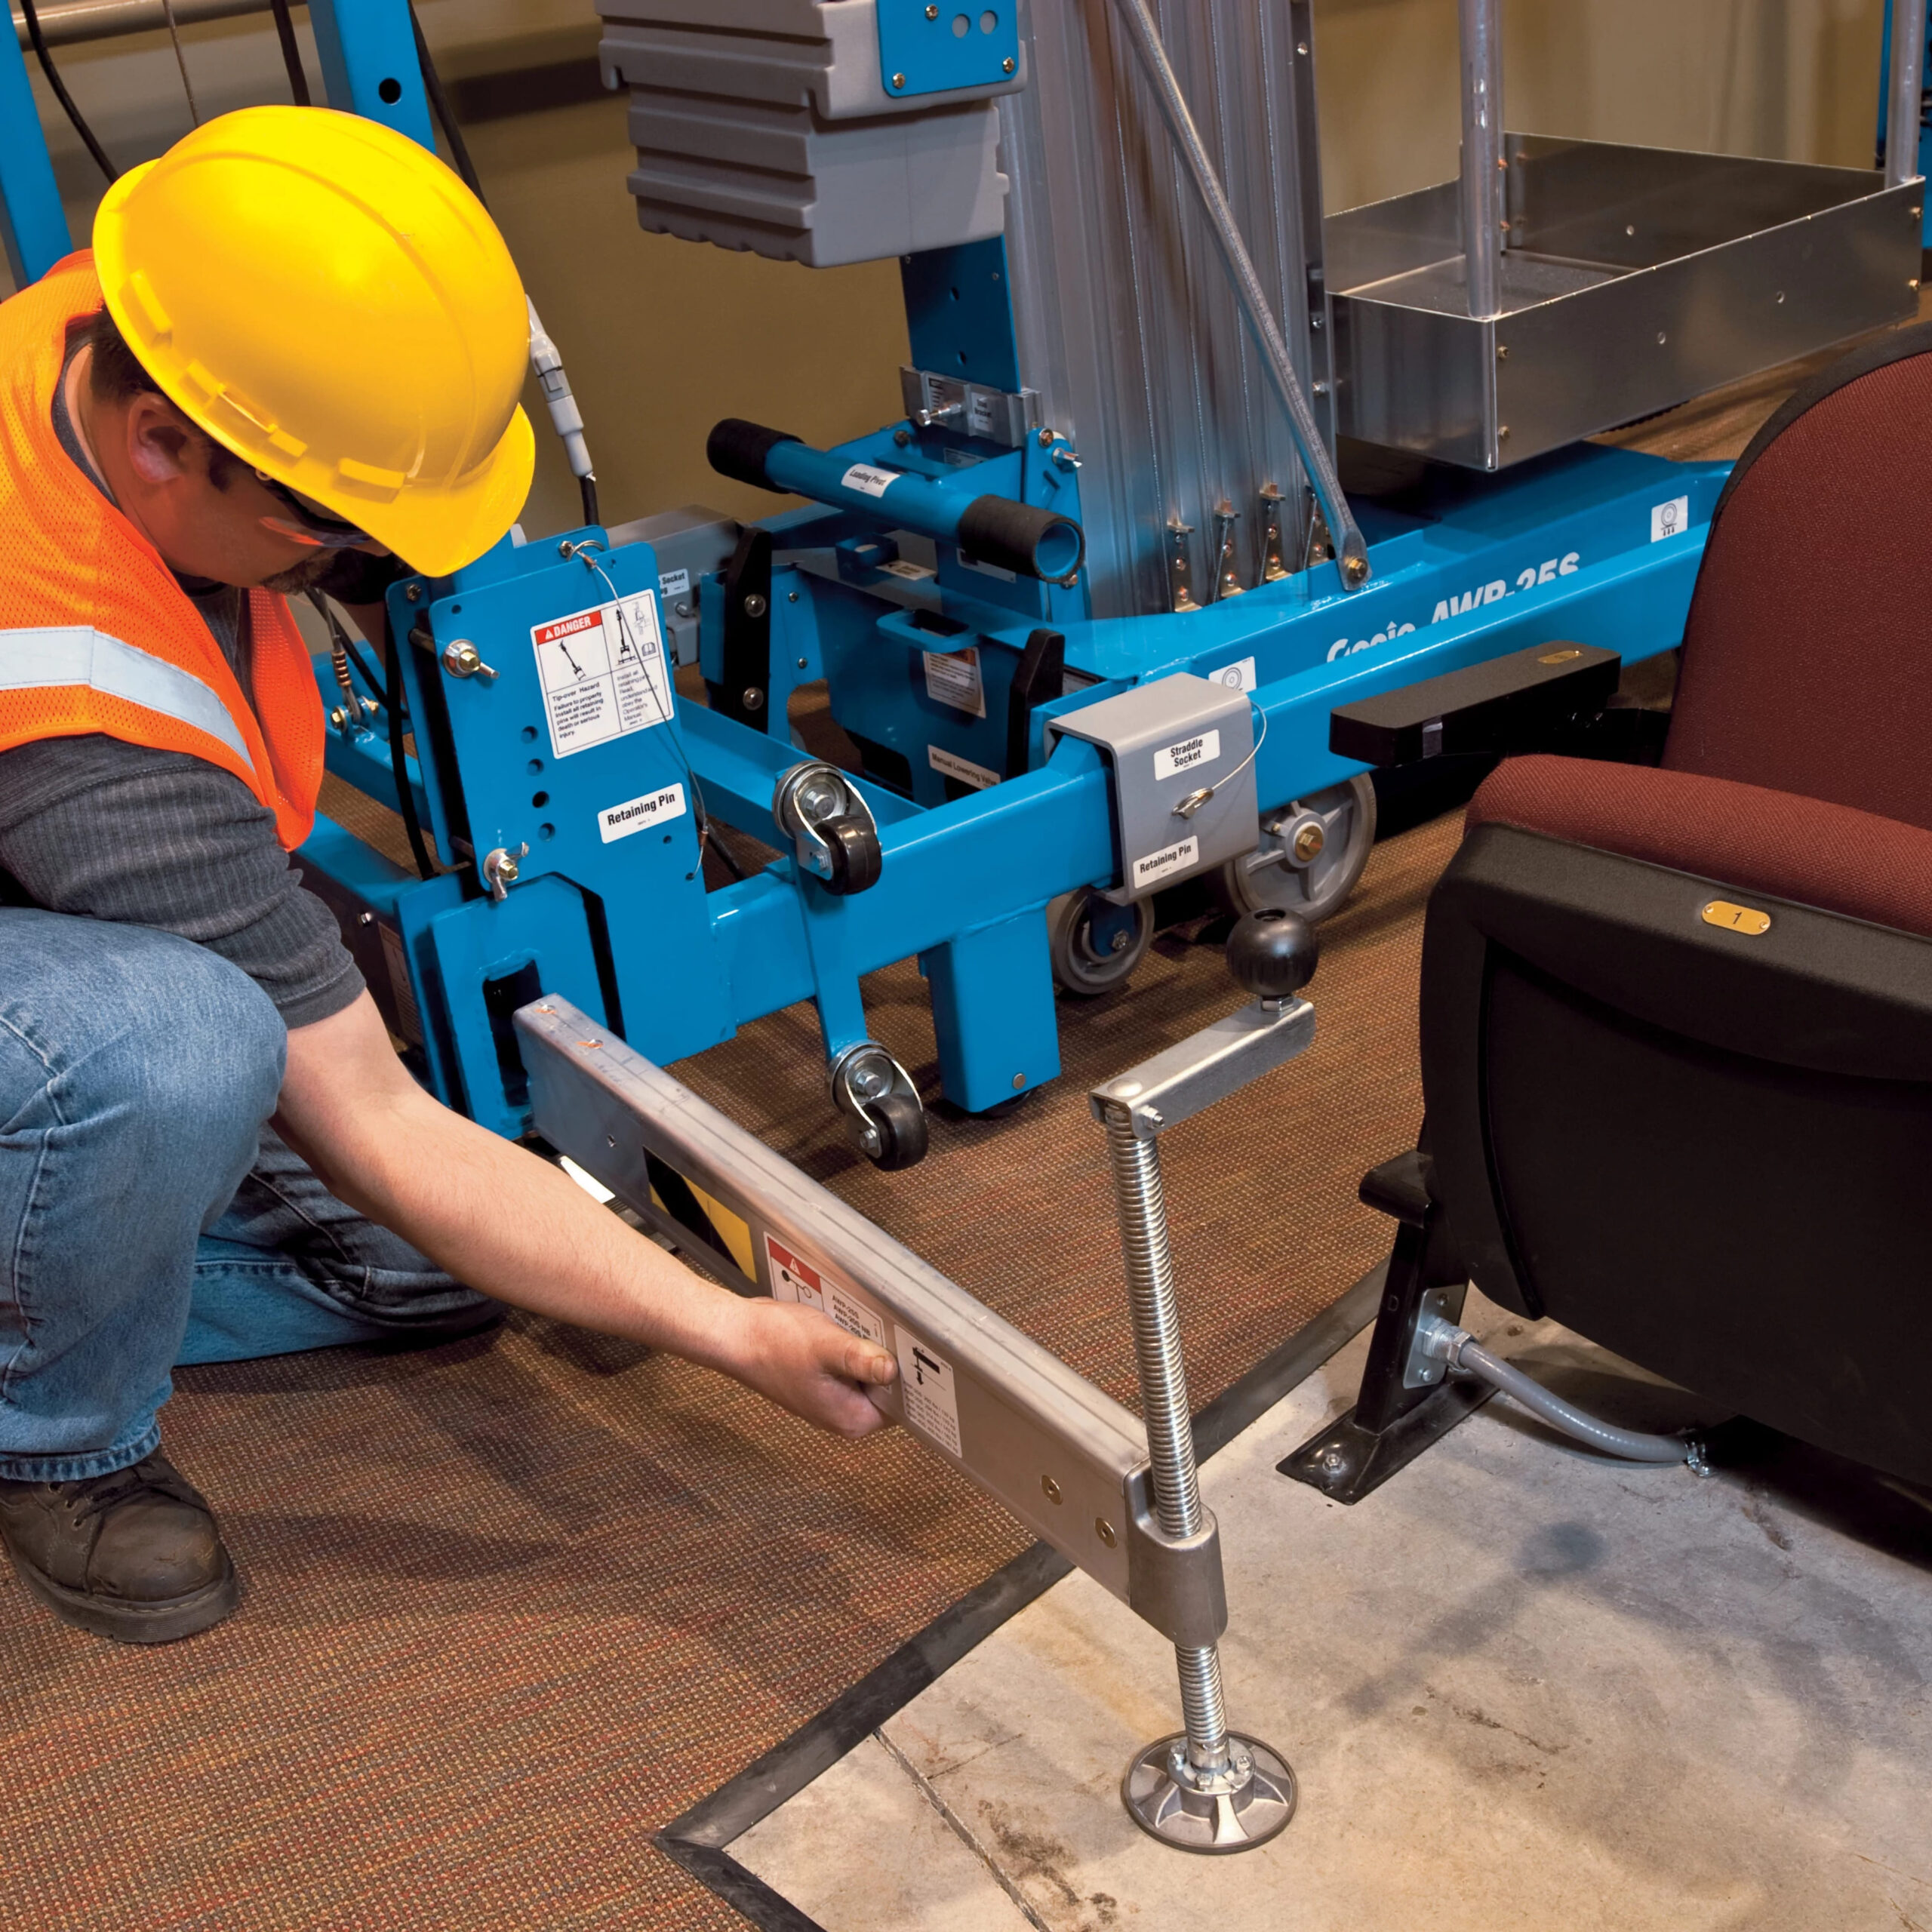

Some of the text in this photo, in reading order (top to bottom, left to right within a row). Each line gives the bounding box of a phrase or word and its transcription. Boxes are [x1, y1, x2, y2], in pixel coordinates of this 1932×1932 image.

[662, 572, 685, 585] Socket
[553, 616, 592, 637] DANGER
[552, 681, 601, 702] Tip-over Hazard
[1171, 738, 1203, 758] Straddle
[1174, 749, 1201, 767] Socket
[608, 793, 675, 826] Retaining Pin
[1140, 844, 1192, 873] Retaining Pin
[1733, 912, 1743, 924] 1
